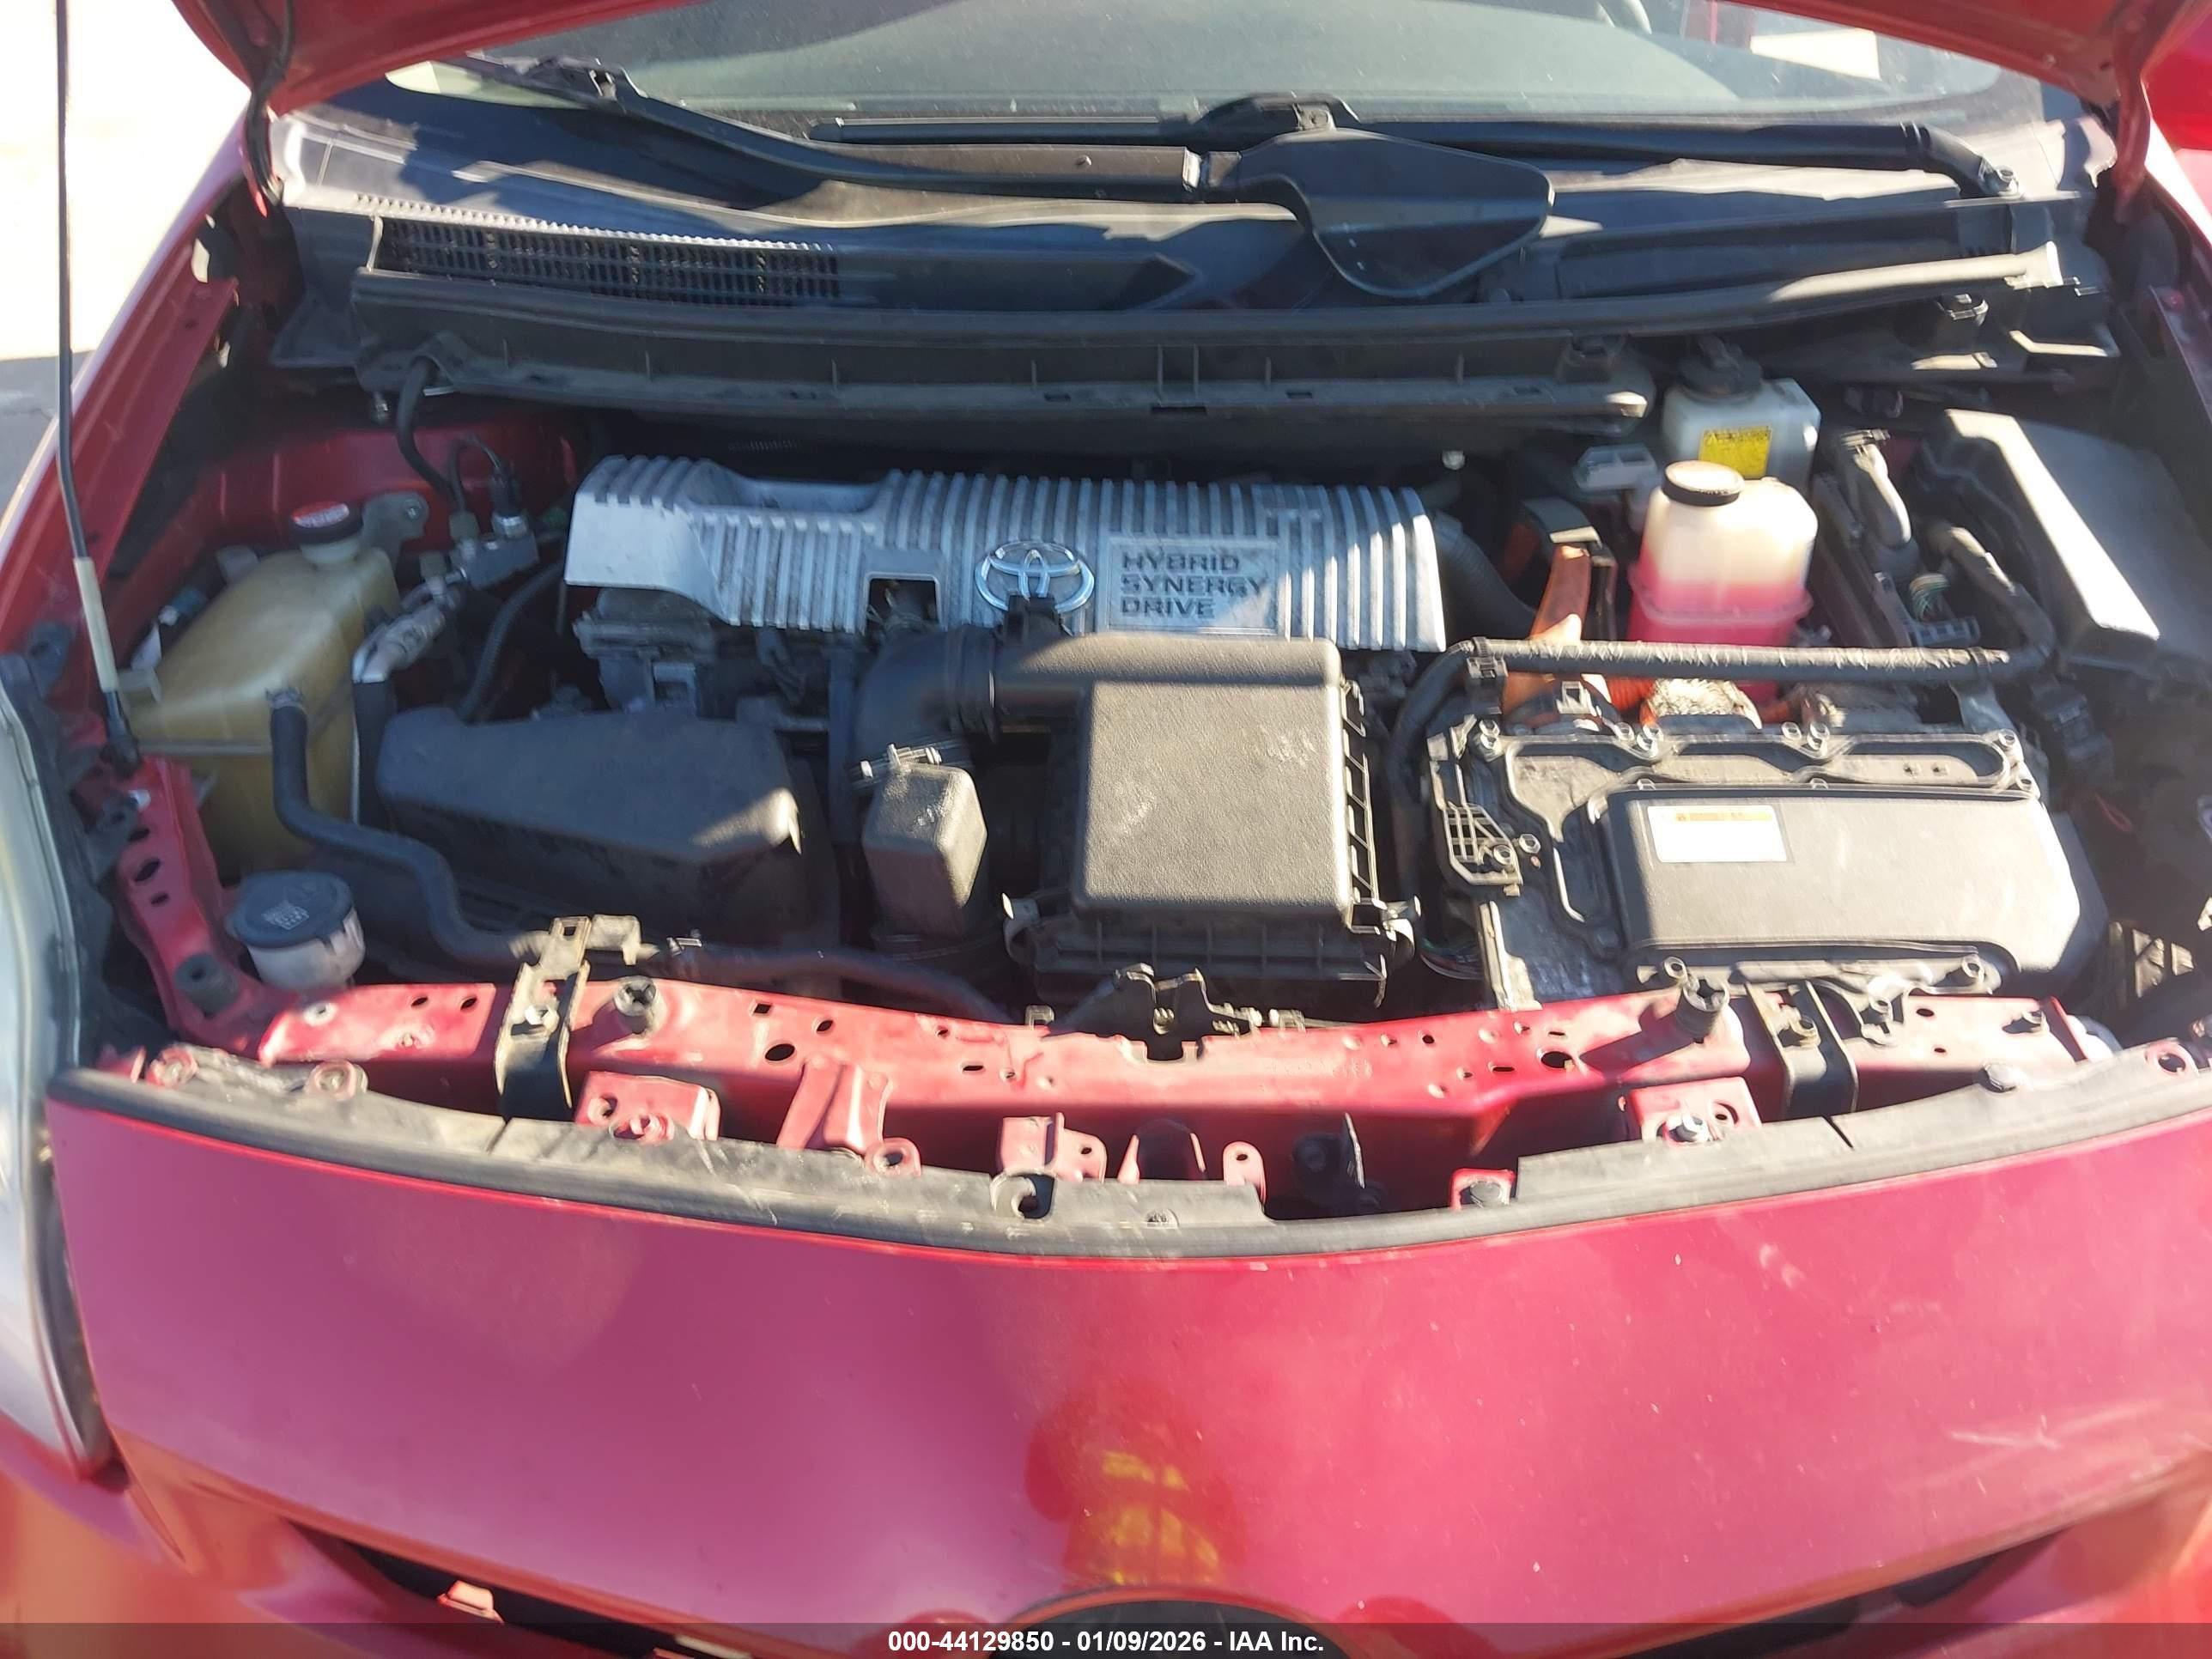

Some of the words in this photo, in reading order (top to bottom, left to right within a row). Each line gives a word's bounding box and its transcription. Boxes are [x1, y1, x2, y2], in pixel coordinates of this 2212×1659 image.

[1122, 551, 1239, 573] HYBRID
[1121, 572, 1268, 596] SYNERGY
[1121, 596, 1215, 617] DRIVE
